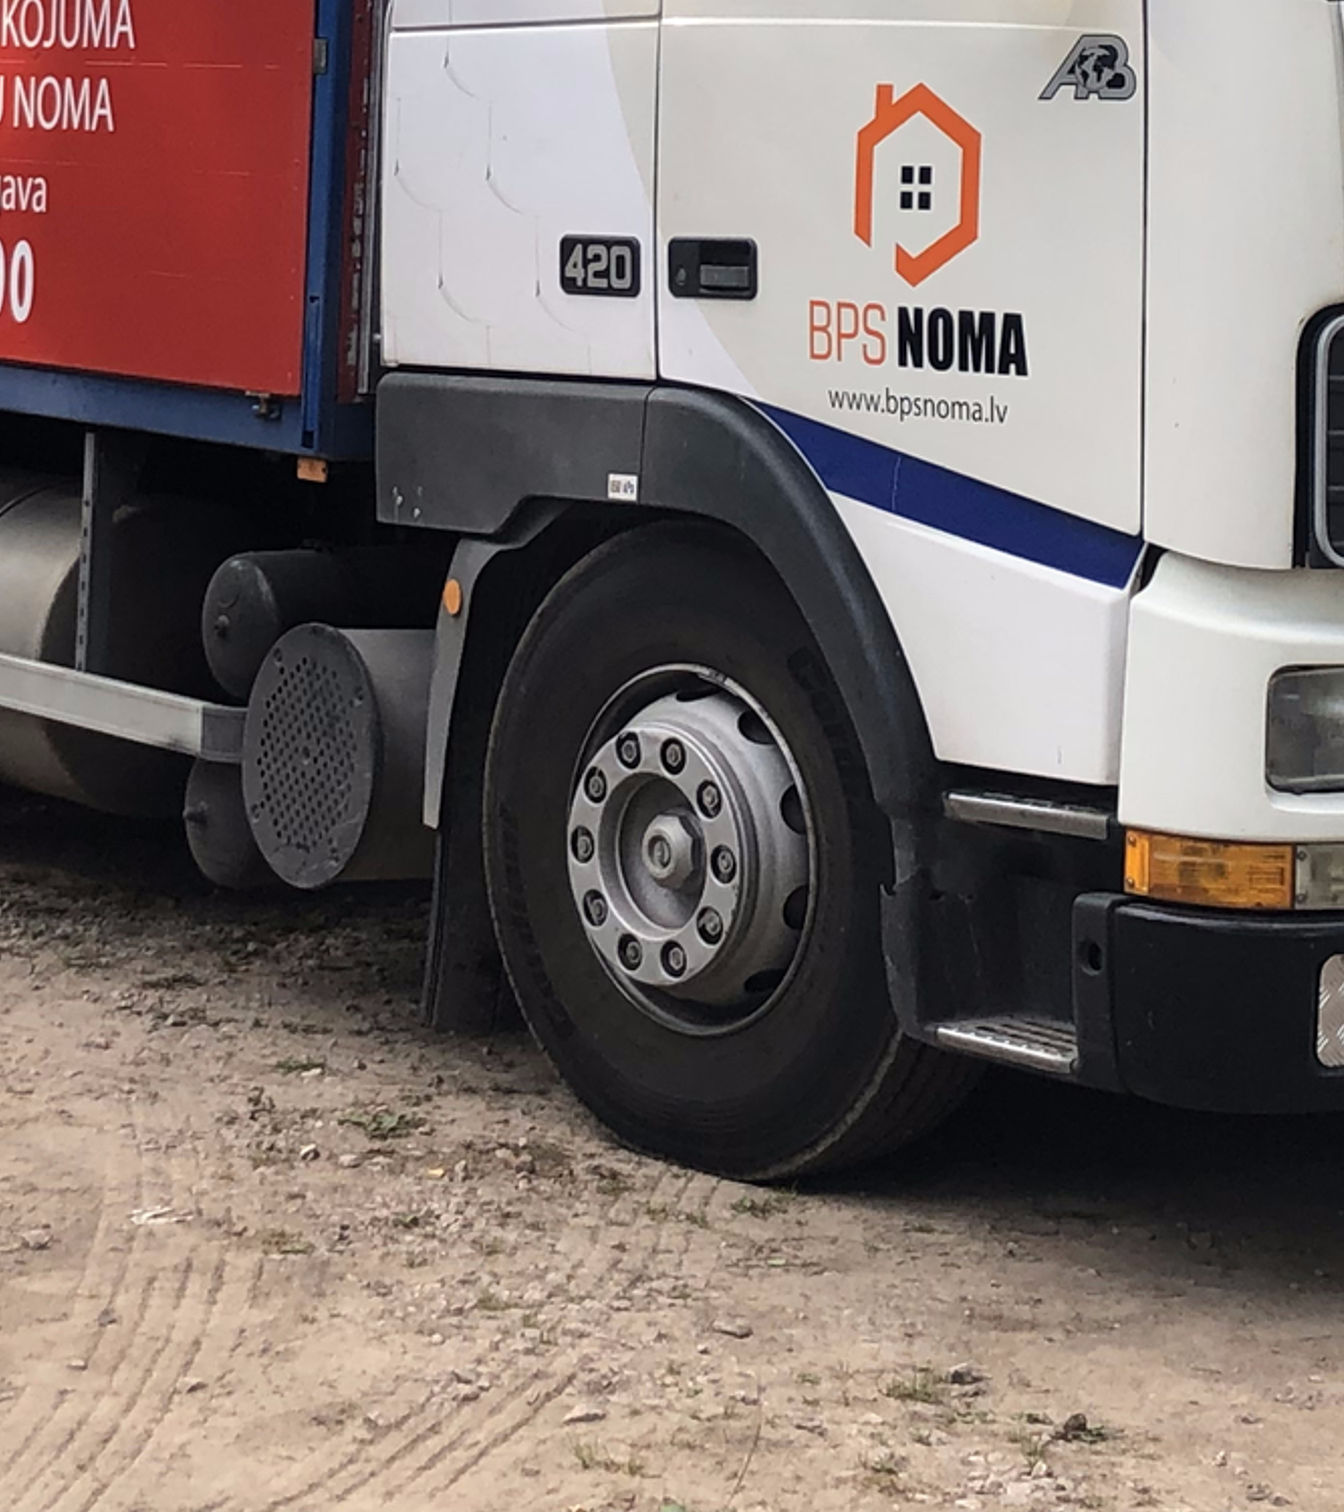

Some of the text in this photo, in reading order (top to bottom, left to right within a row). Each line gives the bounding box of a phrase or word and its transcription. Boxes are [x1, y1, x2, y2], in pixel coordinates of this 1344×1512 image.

[13, 76, 115, 132] NOMA
[564, 243, 632, 288] 420
[809, 299, 1028, 376] BPS NOMA
[828, 387, 1008, 423] www.bpsnoma.lv
